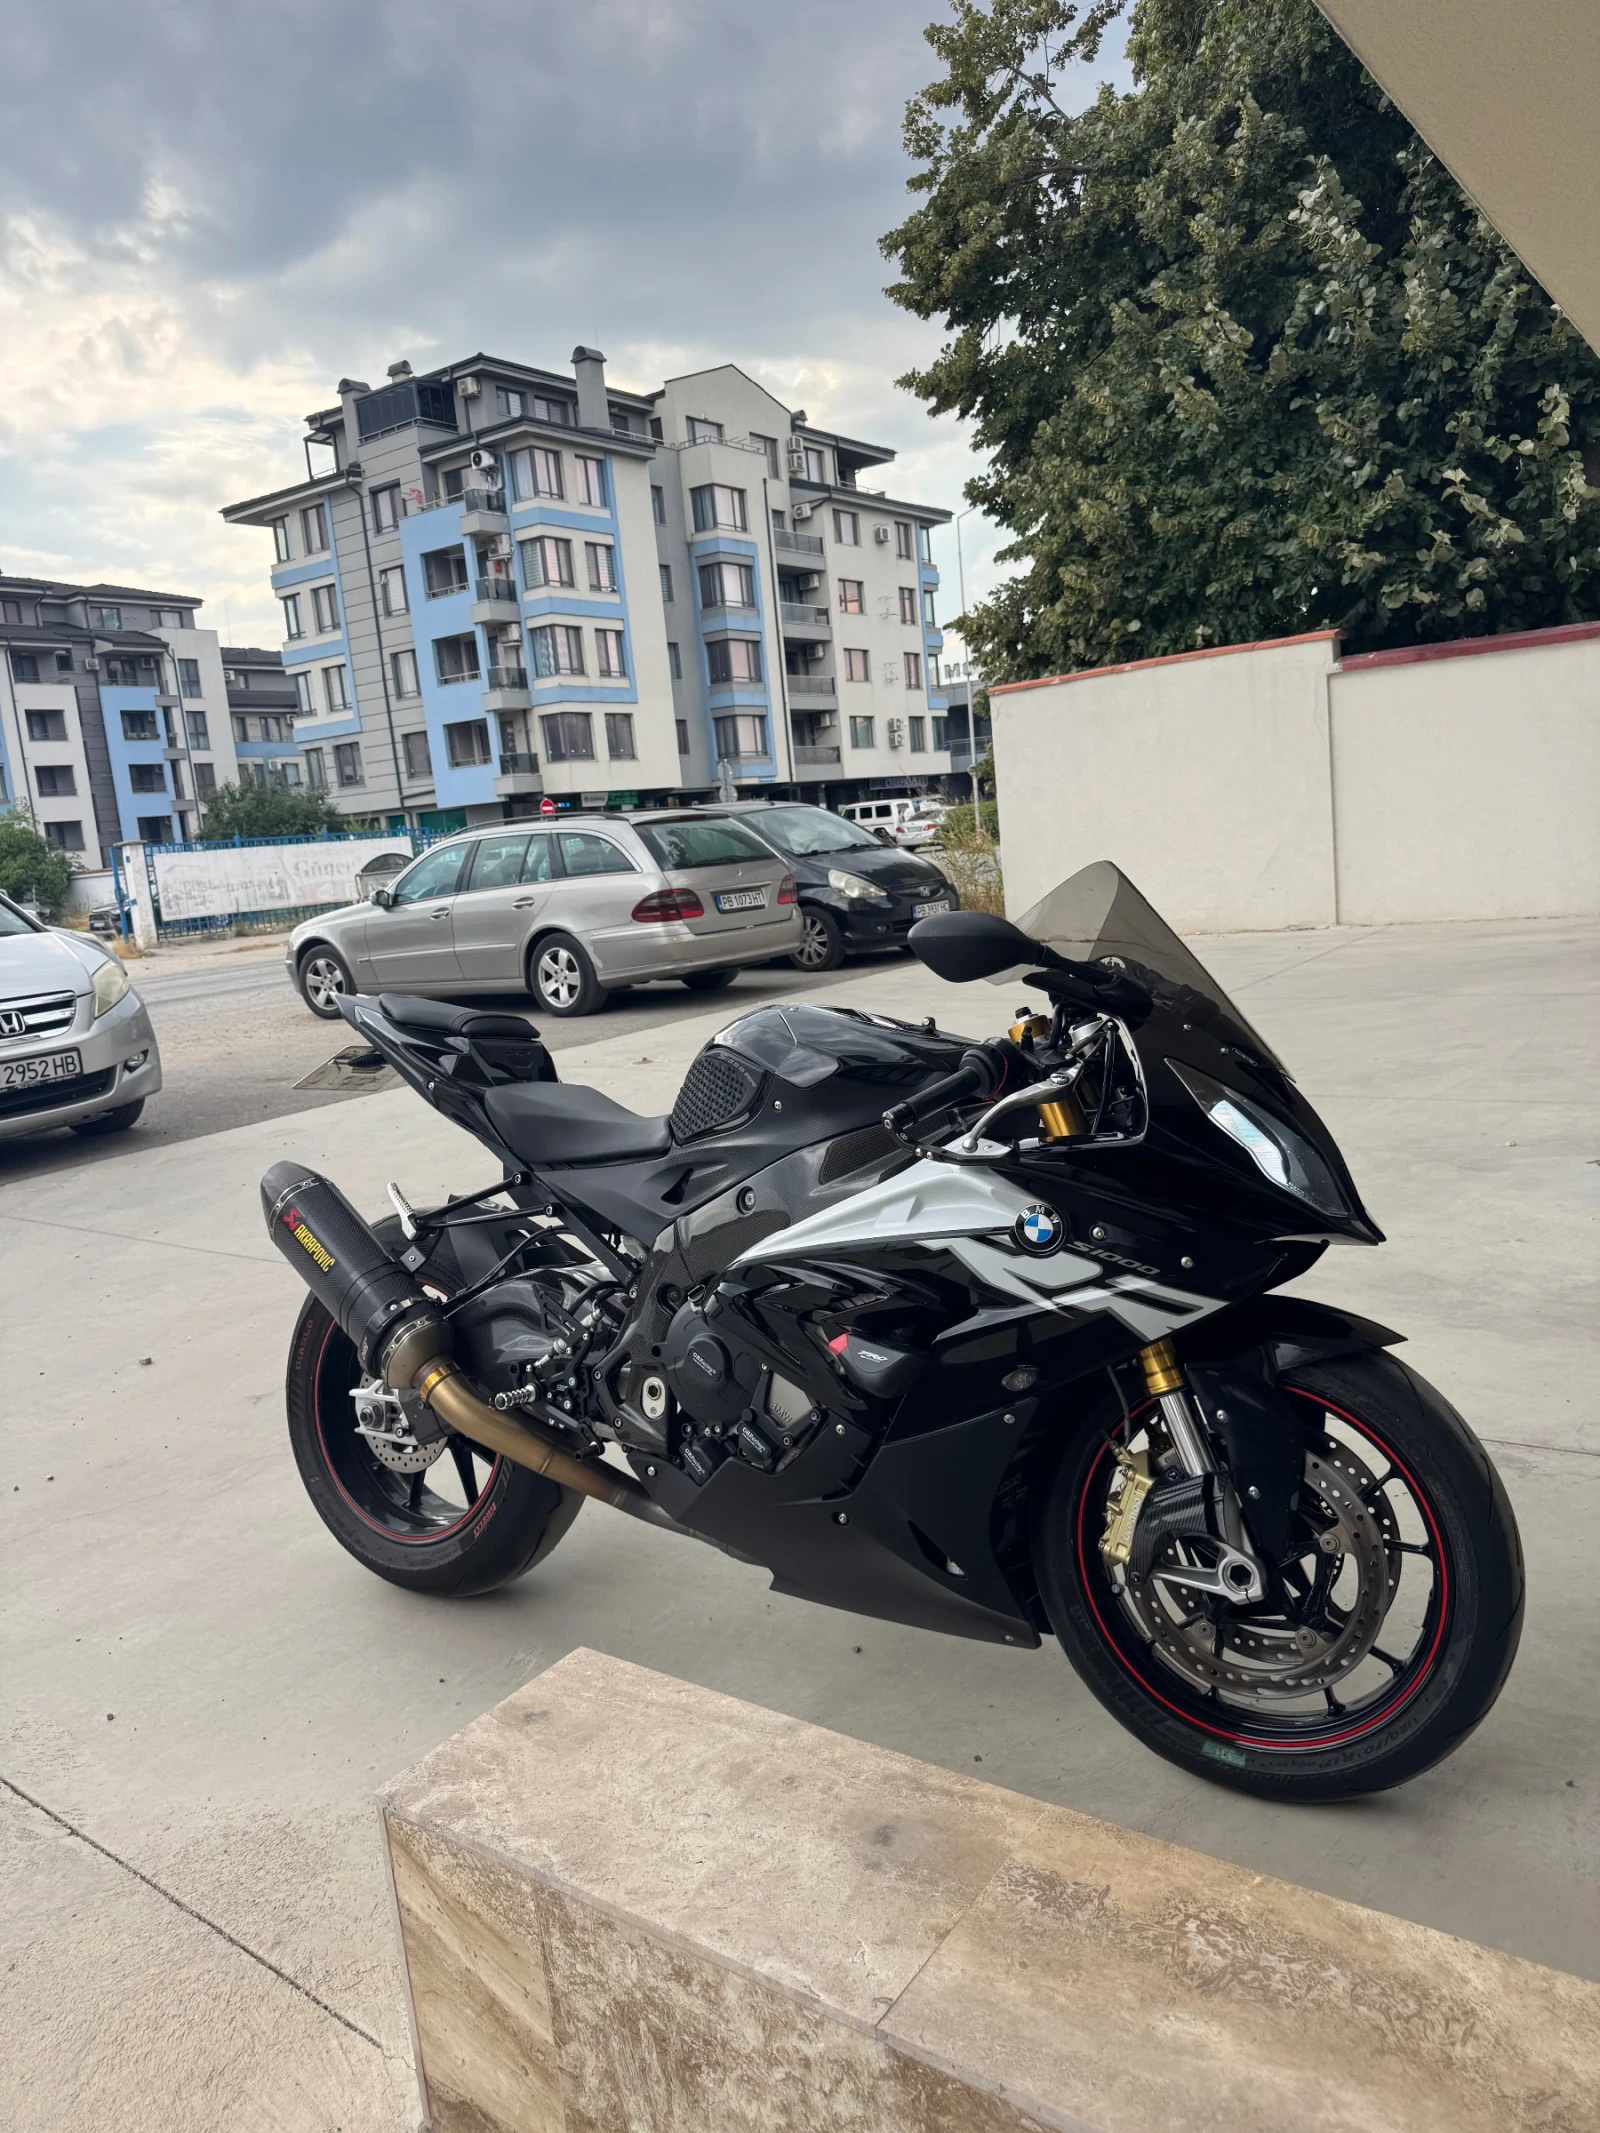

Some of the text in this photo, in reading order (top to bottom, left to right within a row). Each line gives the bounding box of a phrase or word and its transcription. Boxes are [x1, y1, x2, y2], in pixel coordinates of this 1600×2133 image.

[722, 896, 733, 908] PB
[734, 893, 753, 906] 1073
[917, 906, 927, 917] PB
[3, 1055, 77, 1084] 2952 HB
[770, 1400, 793, 1423] BMW
